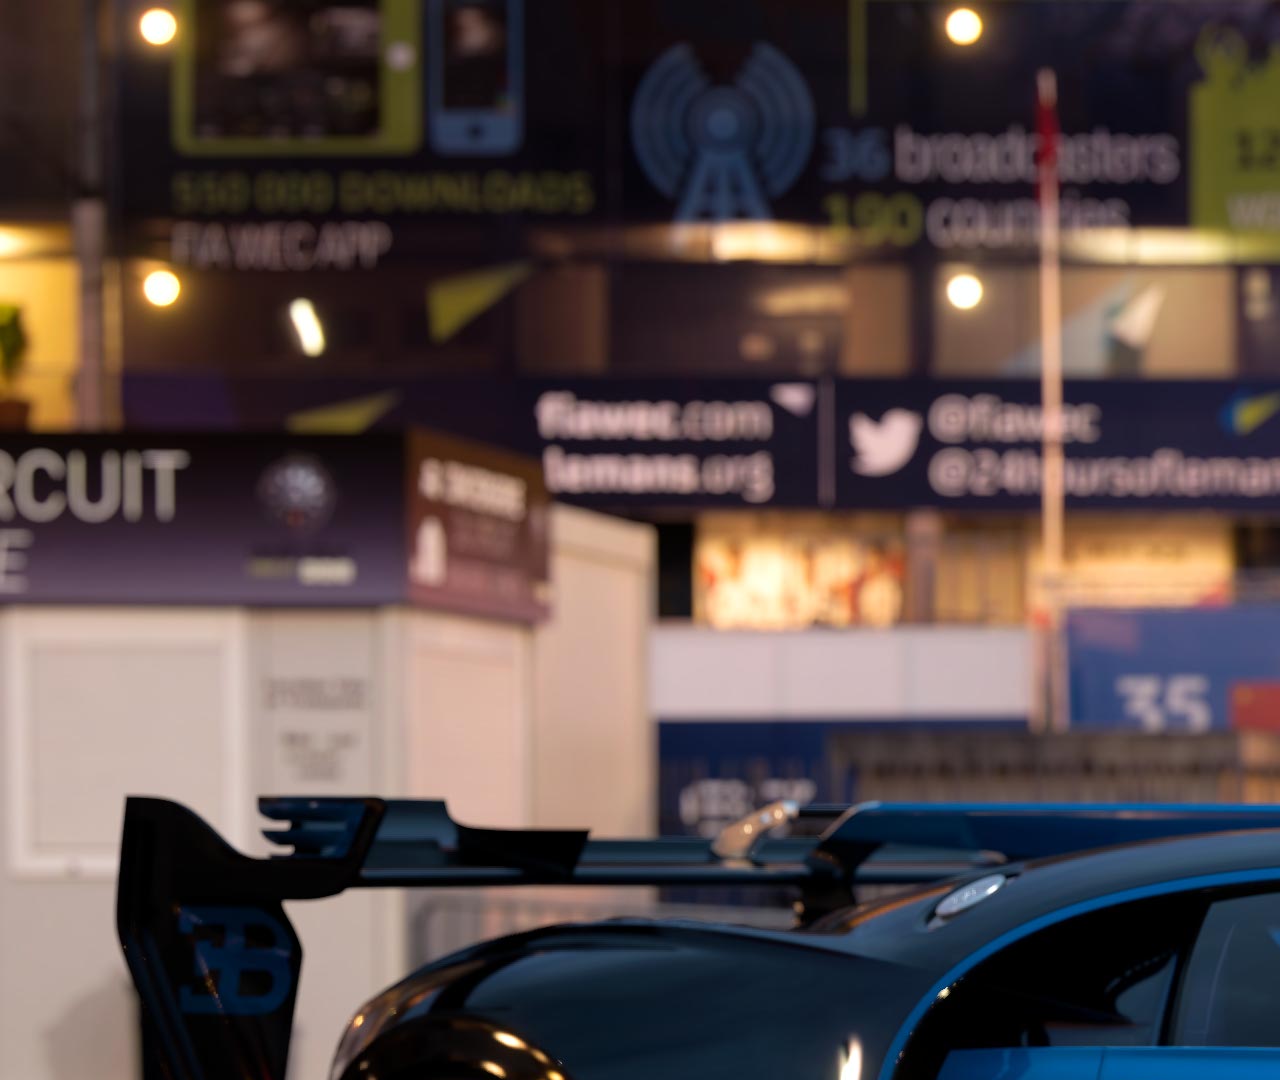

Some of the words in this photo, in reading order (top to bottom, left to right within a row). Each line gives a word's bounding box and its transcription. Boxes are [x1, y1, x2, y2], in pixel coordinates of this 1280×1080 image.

[338, 170, 595, 214] DOWNLOADS
[925, 189, 1131, 247] counies
[535, 390, 774, 441] fiawec.com
[542, 445, 776, 503] lemans.org
